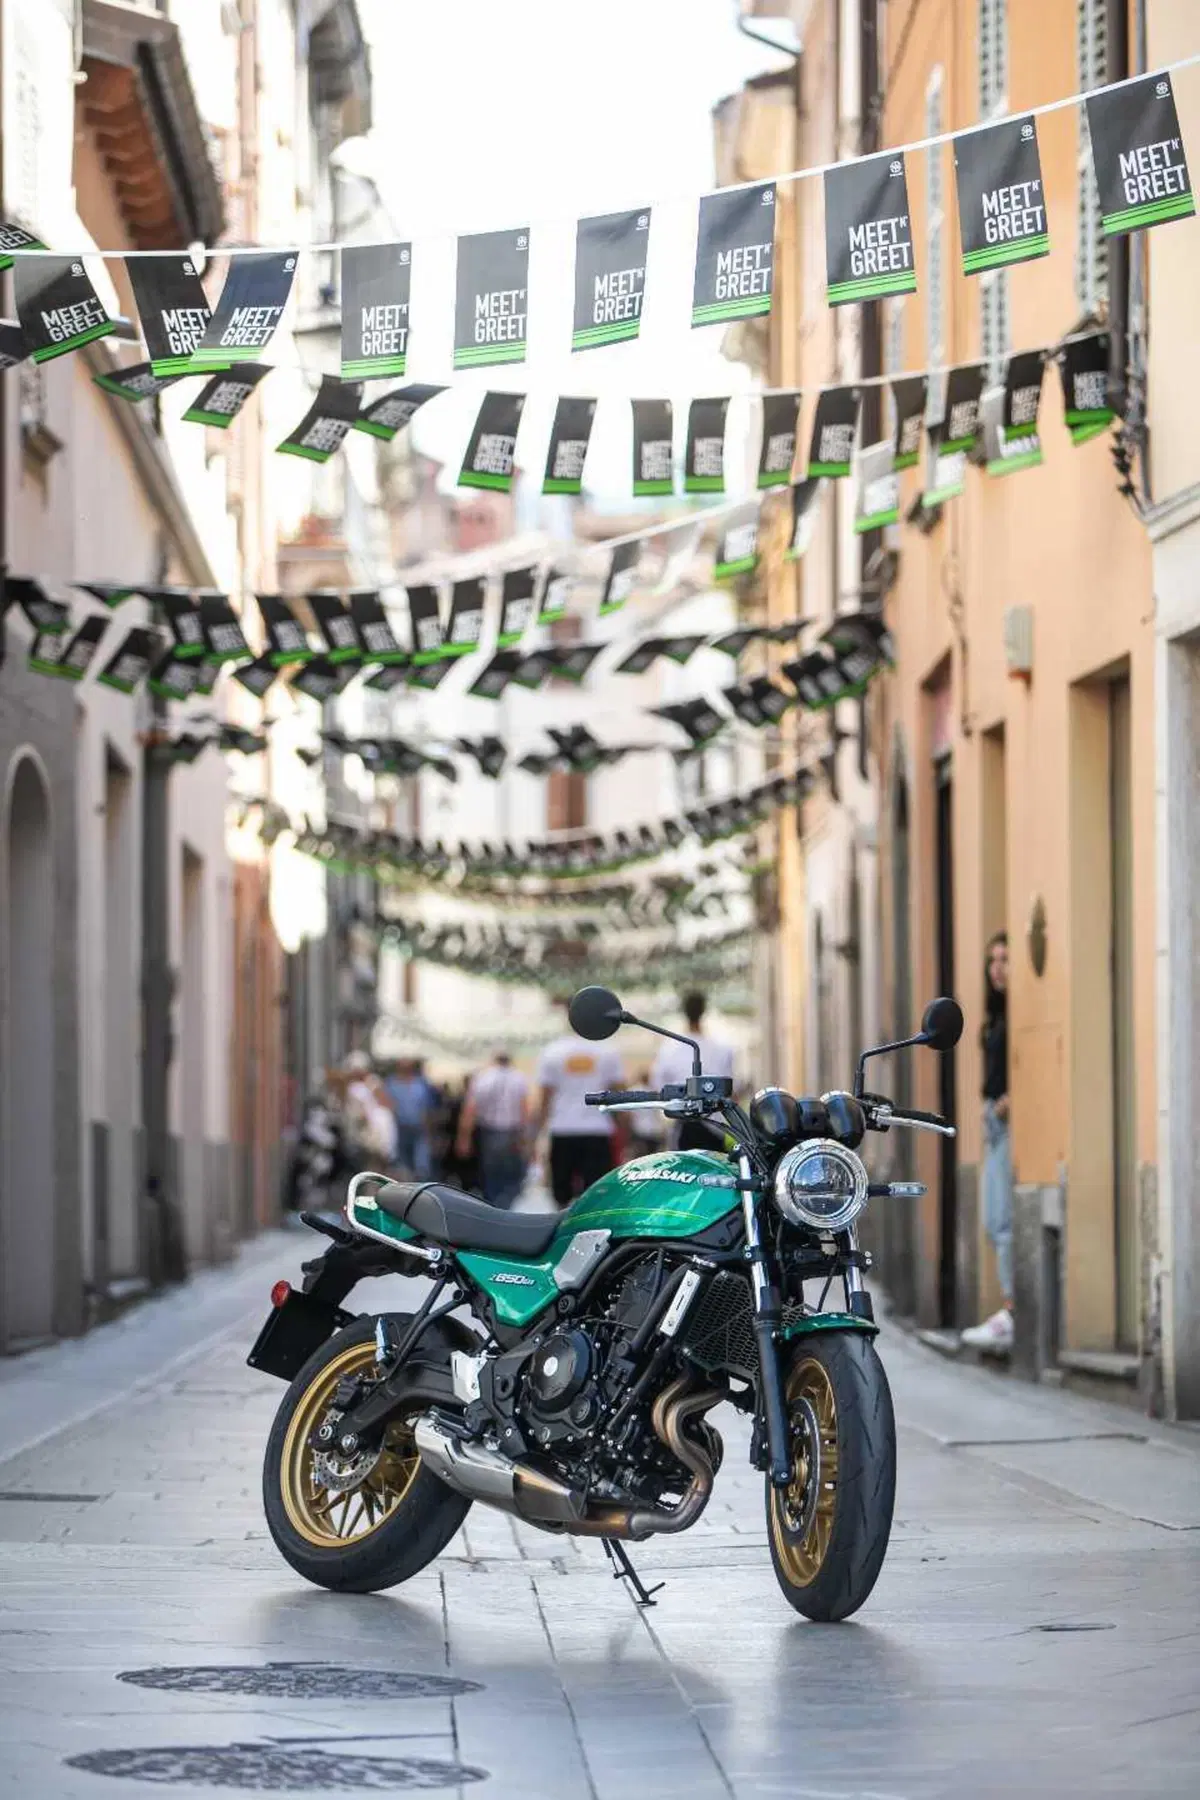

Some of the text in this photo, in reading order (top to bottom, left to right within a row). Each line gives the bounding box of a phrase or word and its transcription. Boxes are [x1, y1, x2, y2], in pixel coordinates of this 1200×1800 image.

[1123, 164, 1186, 205] GREET
[984, 205, 1043, 243] GREET
[0, 230, 35, 250] EET
[850, 242, 911, 276] GREET
[715, 268, 771, 299] GREET
[593, 292, 643, 324] GREET
[49, 308, 105, 343] GREET
[219, 326, 276, 346] GREET
[474, 314, 527, 342] GREET
[168, 330, 207, 355] GRE
[361, 328, 407, 355] GREET
